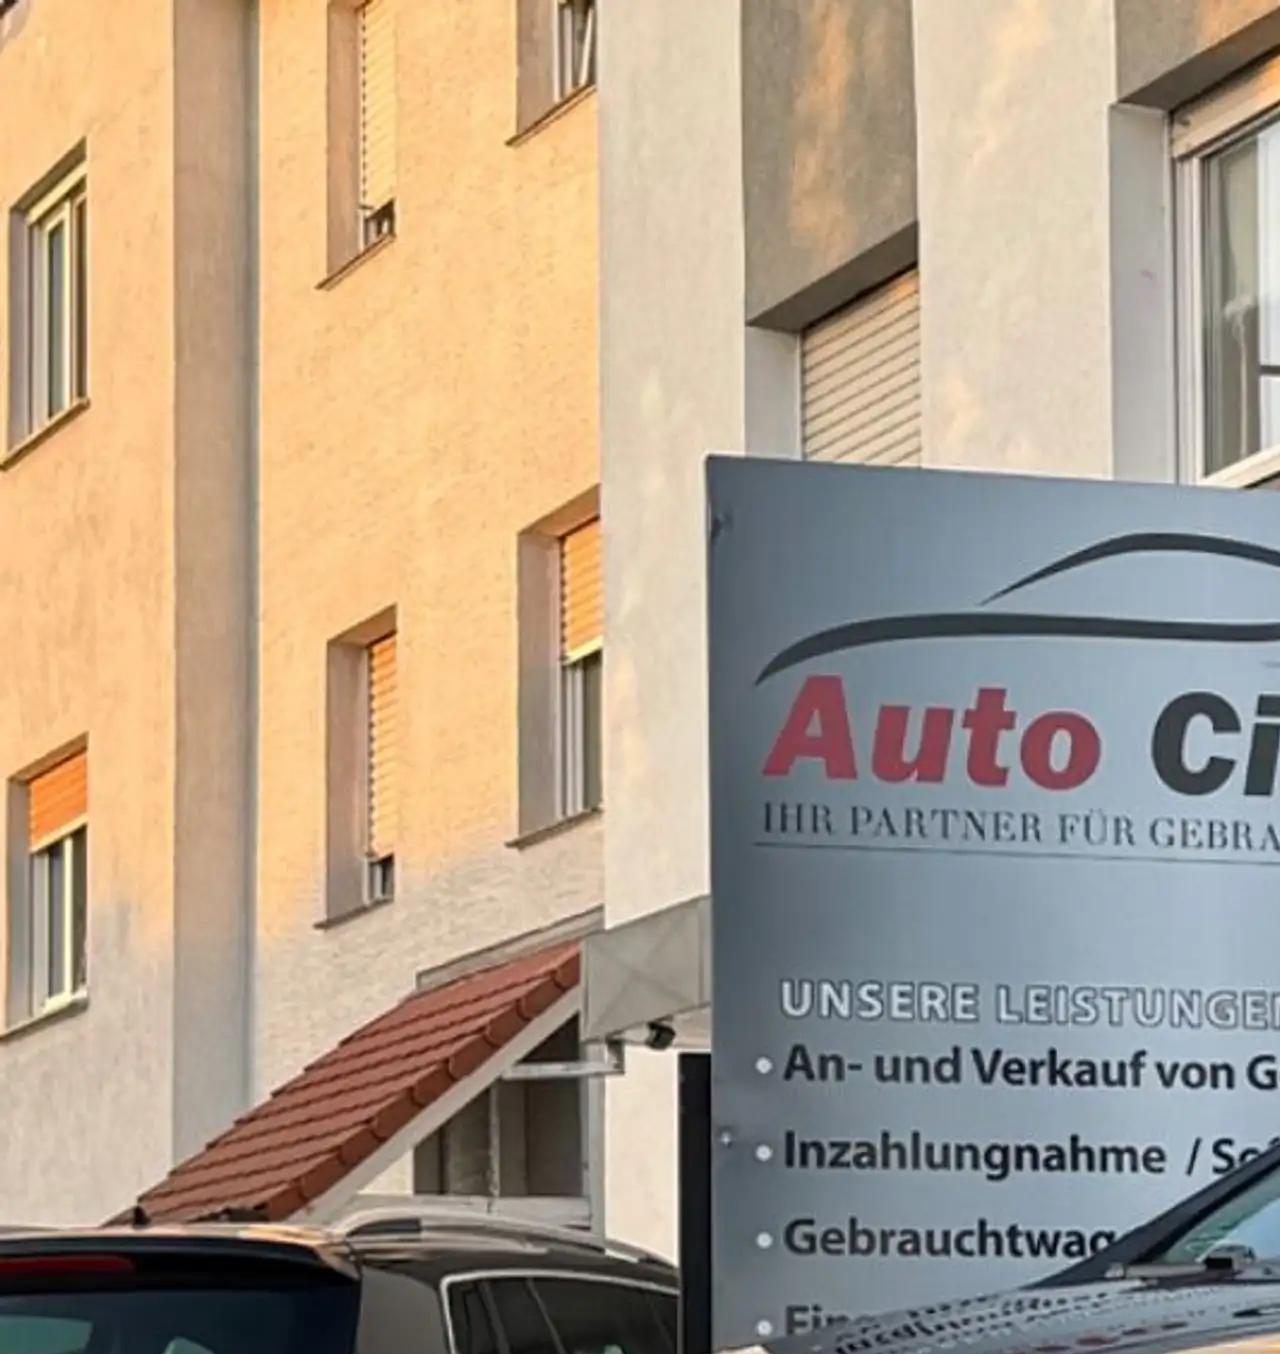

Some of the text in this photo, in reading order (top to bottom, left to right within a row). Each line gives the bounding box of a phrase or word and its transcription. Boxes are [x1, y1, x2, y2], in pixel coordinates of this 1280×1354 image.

[763, 674, 1100, 791] Auto
[763, 801, 833, 836] IHR
[850, 806, 1042, 843] PARTNER
[1058, 808, 1136, 846] FÜR
[780, 978, 980, 1024] UNSERE
[783, 1044, 862, 1083] An-
[874, 1046, 961, 1084] und
[970, 1047, 1148, 1088] Verkauf
[1154, 1060, 1236, 1090] von
[784, 1130, 1167, 1181] Inzahlungnahme
